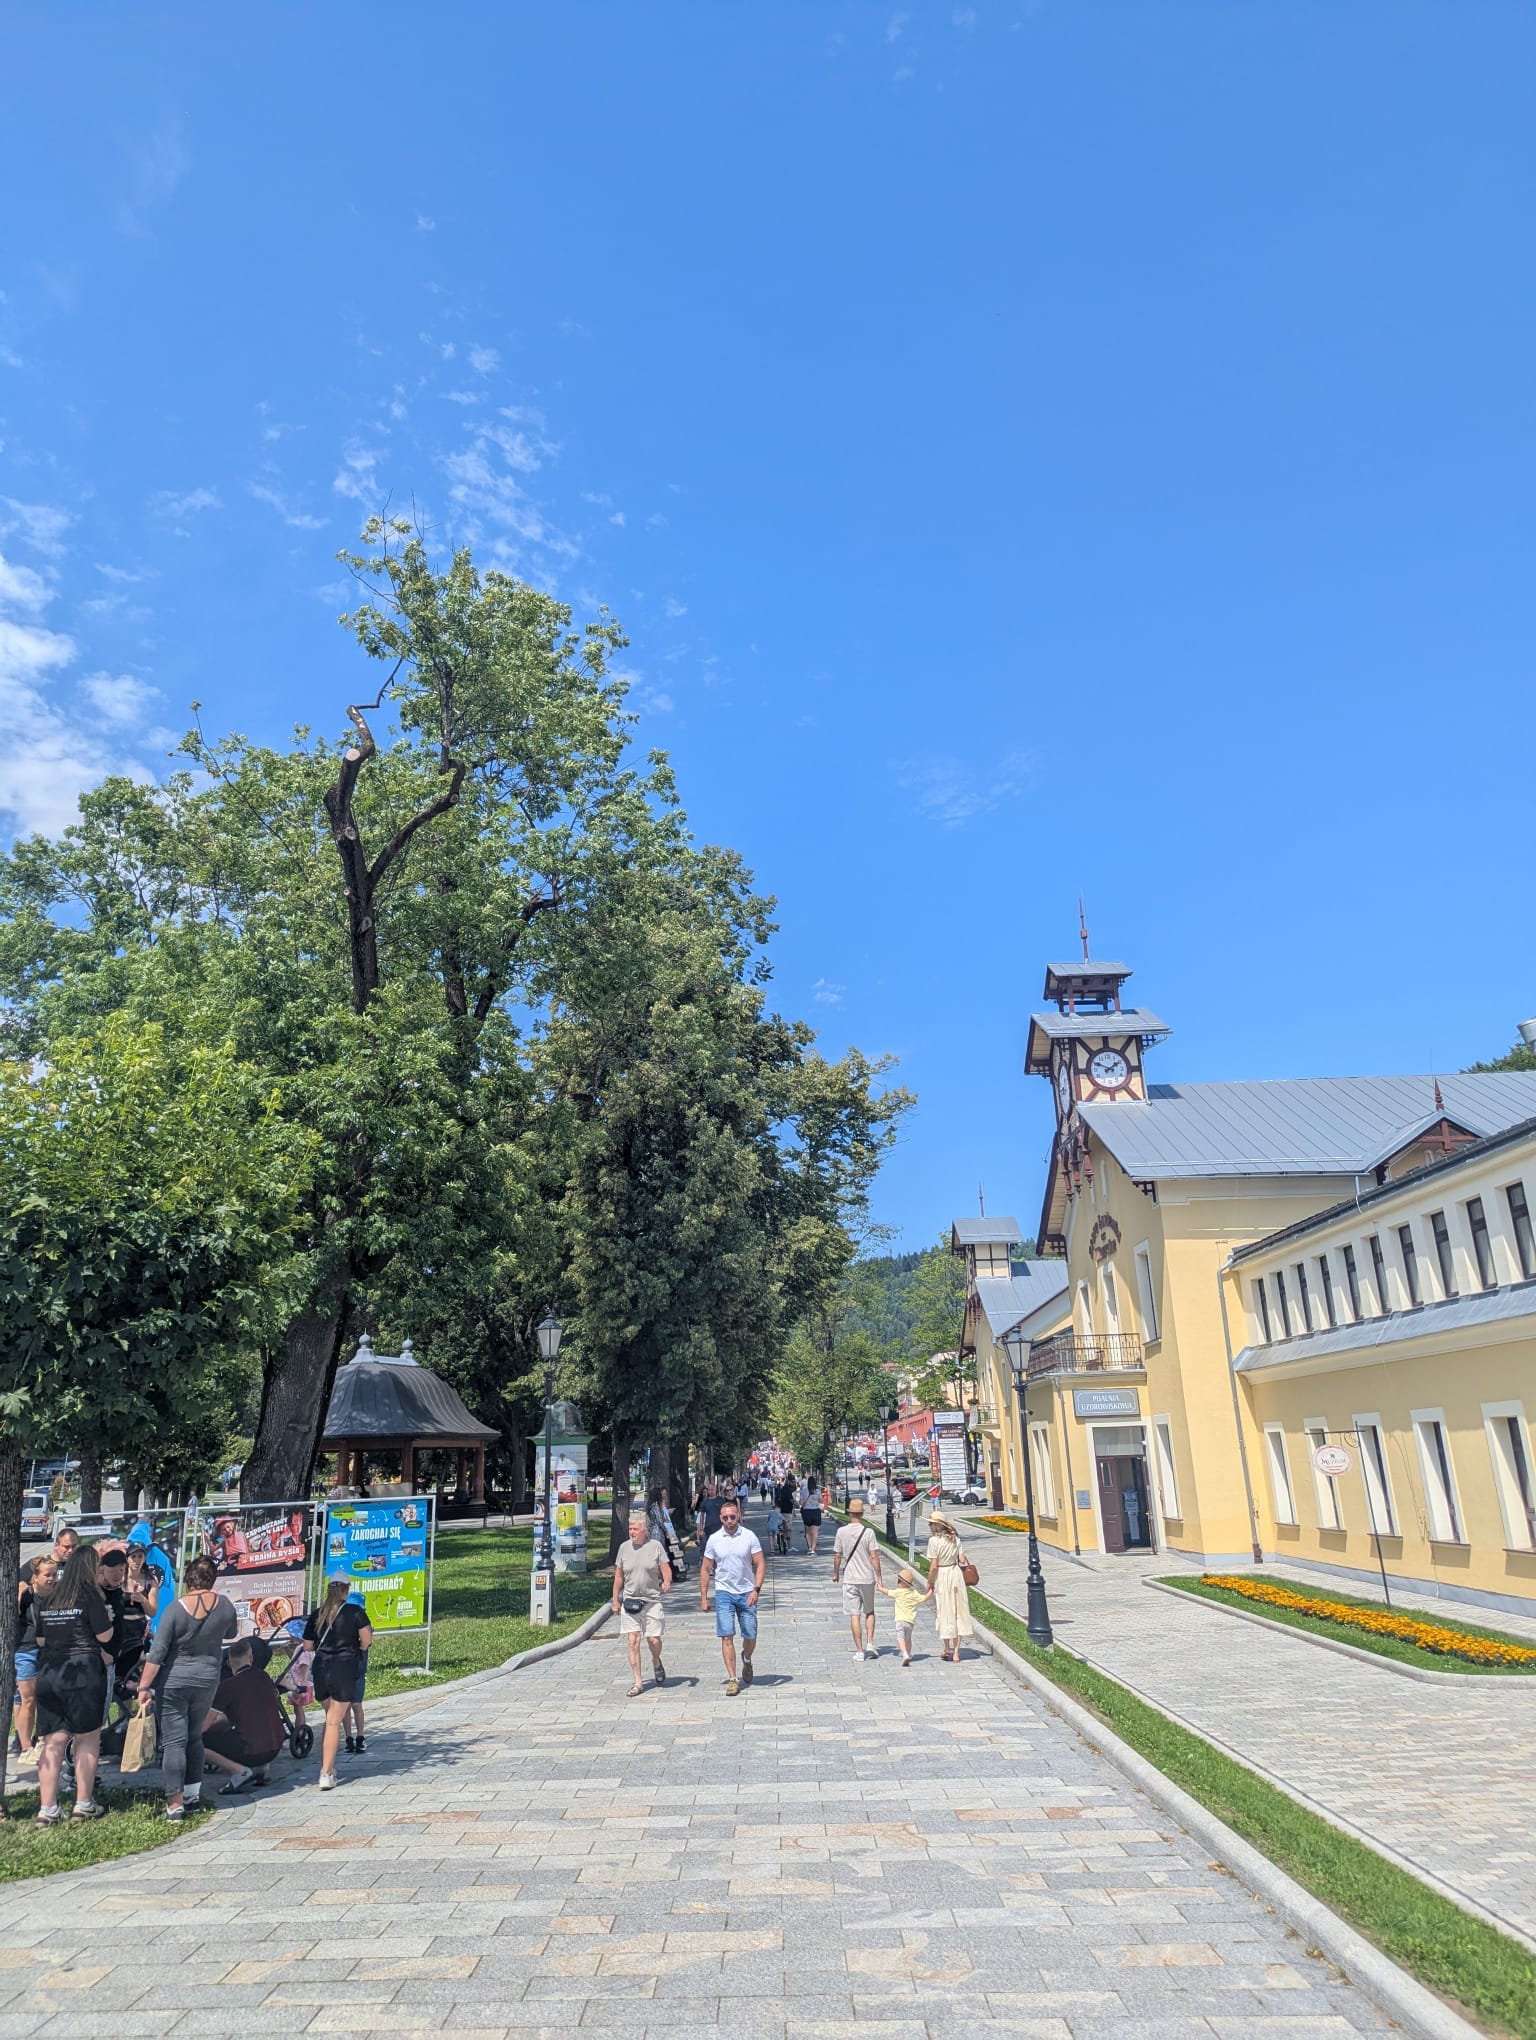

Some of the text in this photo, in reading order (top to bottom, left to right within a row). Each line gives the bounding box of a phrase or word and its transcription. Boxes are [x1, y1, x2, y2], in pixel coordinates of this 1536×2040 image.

[350, 1526, 401, 1541] ZAKOCHAJ SIĘ
[250, 1551, 277, 1562] KRAINA
[278, 1547, 300, 1557] RYSIA
[362, 1575, 404, 1592] DOJECHAĆ?
